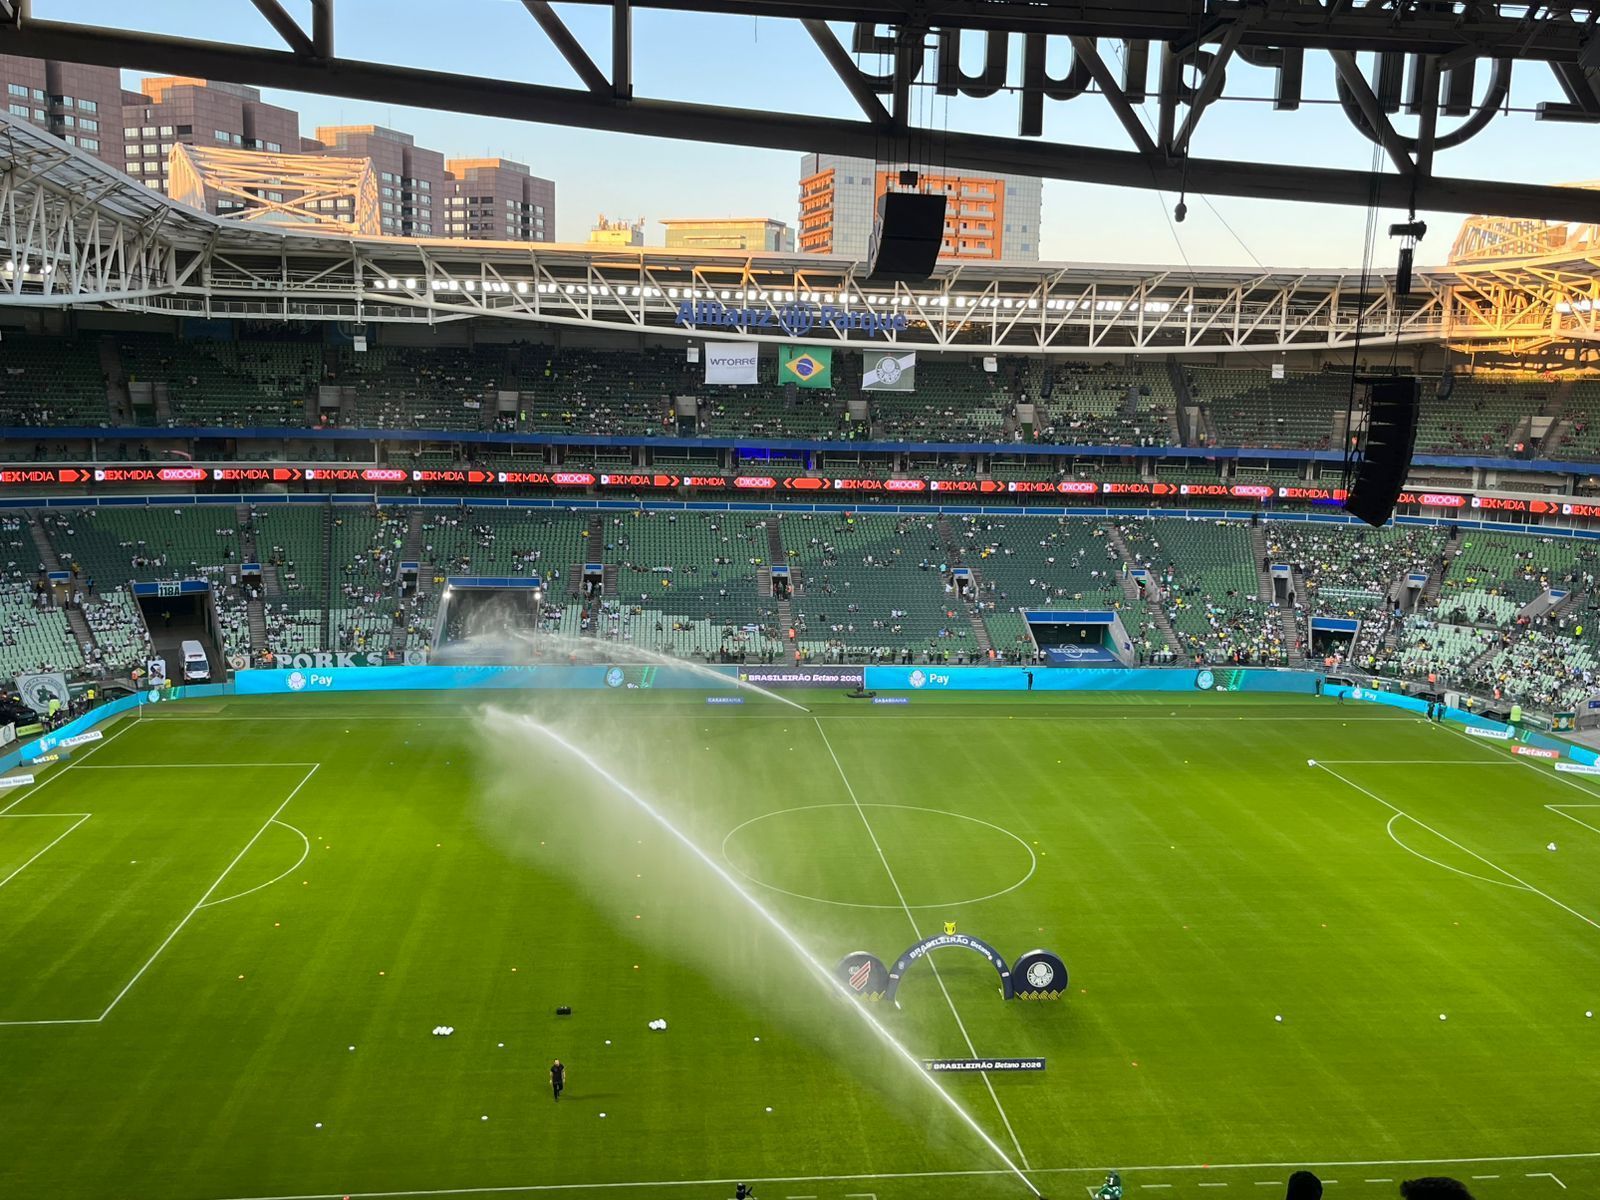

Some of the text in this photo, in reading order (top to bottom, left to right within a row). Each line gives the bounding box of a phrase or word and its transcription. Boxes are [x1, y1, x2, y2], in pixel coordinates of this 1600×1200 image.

[675, 301, 907, 337] Allianz Parque
[710, 357, 756, 366] WTORRE
[163, 470, 201, 480] DXOOH
[367, 471, 401, 480] DXOOH
[556, 474, 589, 483] DXOOH
[739, 478, 771, 487] DXOOH
[889, 481, 920, 490] DXOOH
[1062, 484, 1093, 492] DXOOH
[1235, 487, 1268, 496] DXOOH
[1423, 495, 1459, 504] DXOOH
[160, 586, 180, 596] 118A
[275, 651, 383, 669] PORK'S
[310, 674, 333, 687] Pay
[748, 673, 811, 681] BRASILEIRÃO
[812, 674, 839, 682] Betano
[929, 673, 950, 686] Pay
[1517, 747, 1552, 758] Betano
[33, 753, 59, 764] bet365
[909, 936, 969, 959] BRASILEIRÃO
[933, 1061, 1042, 1070] BRASILEIRÃO Betano 2026
